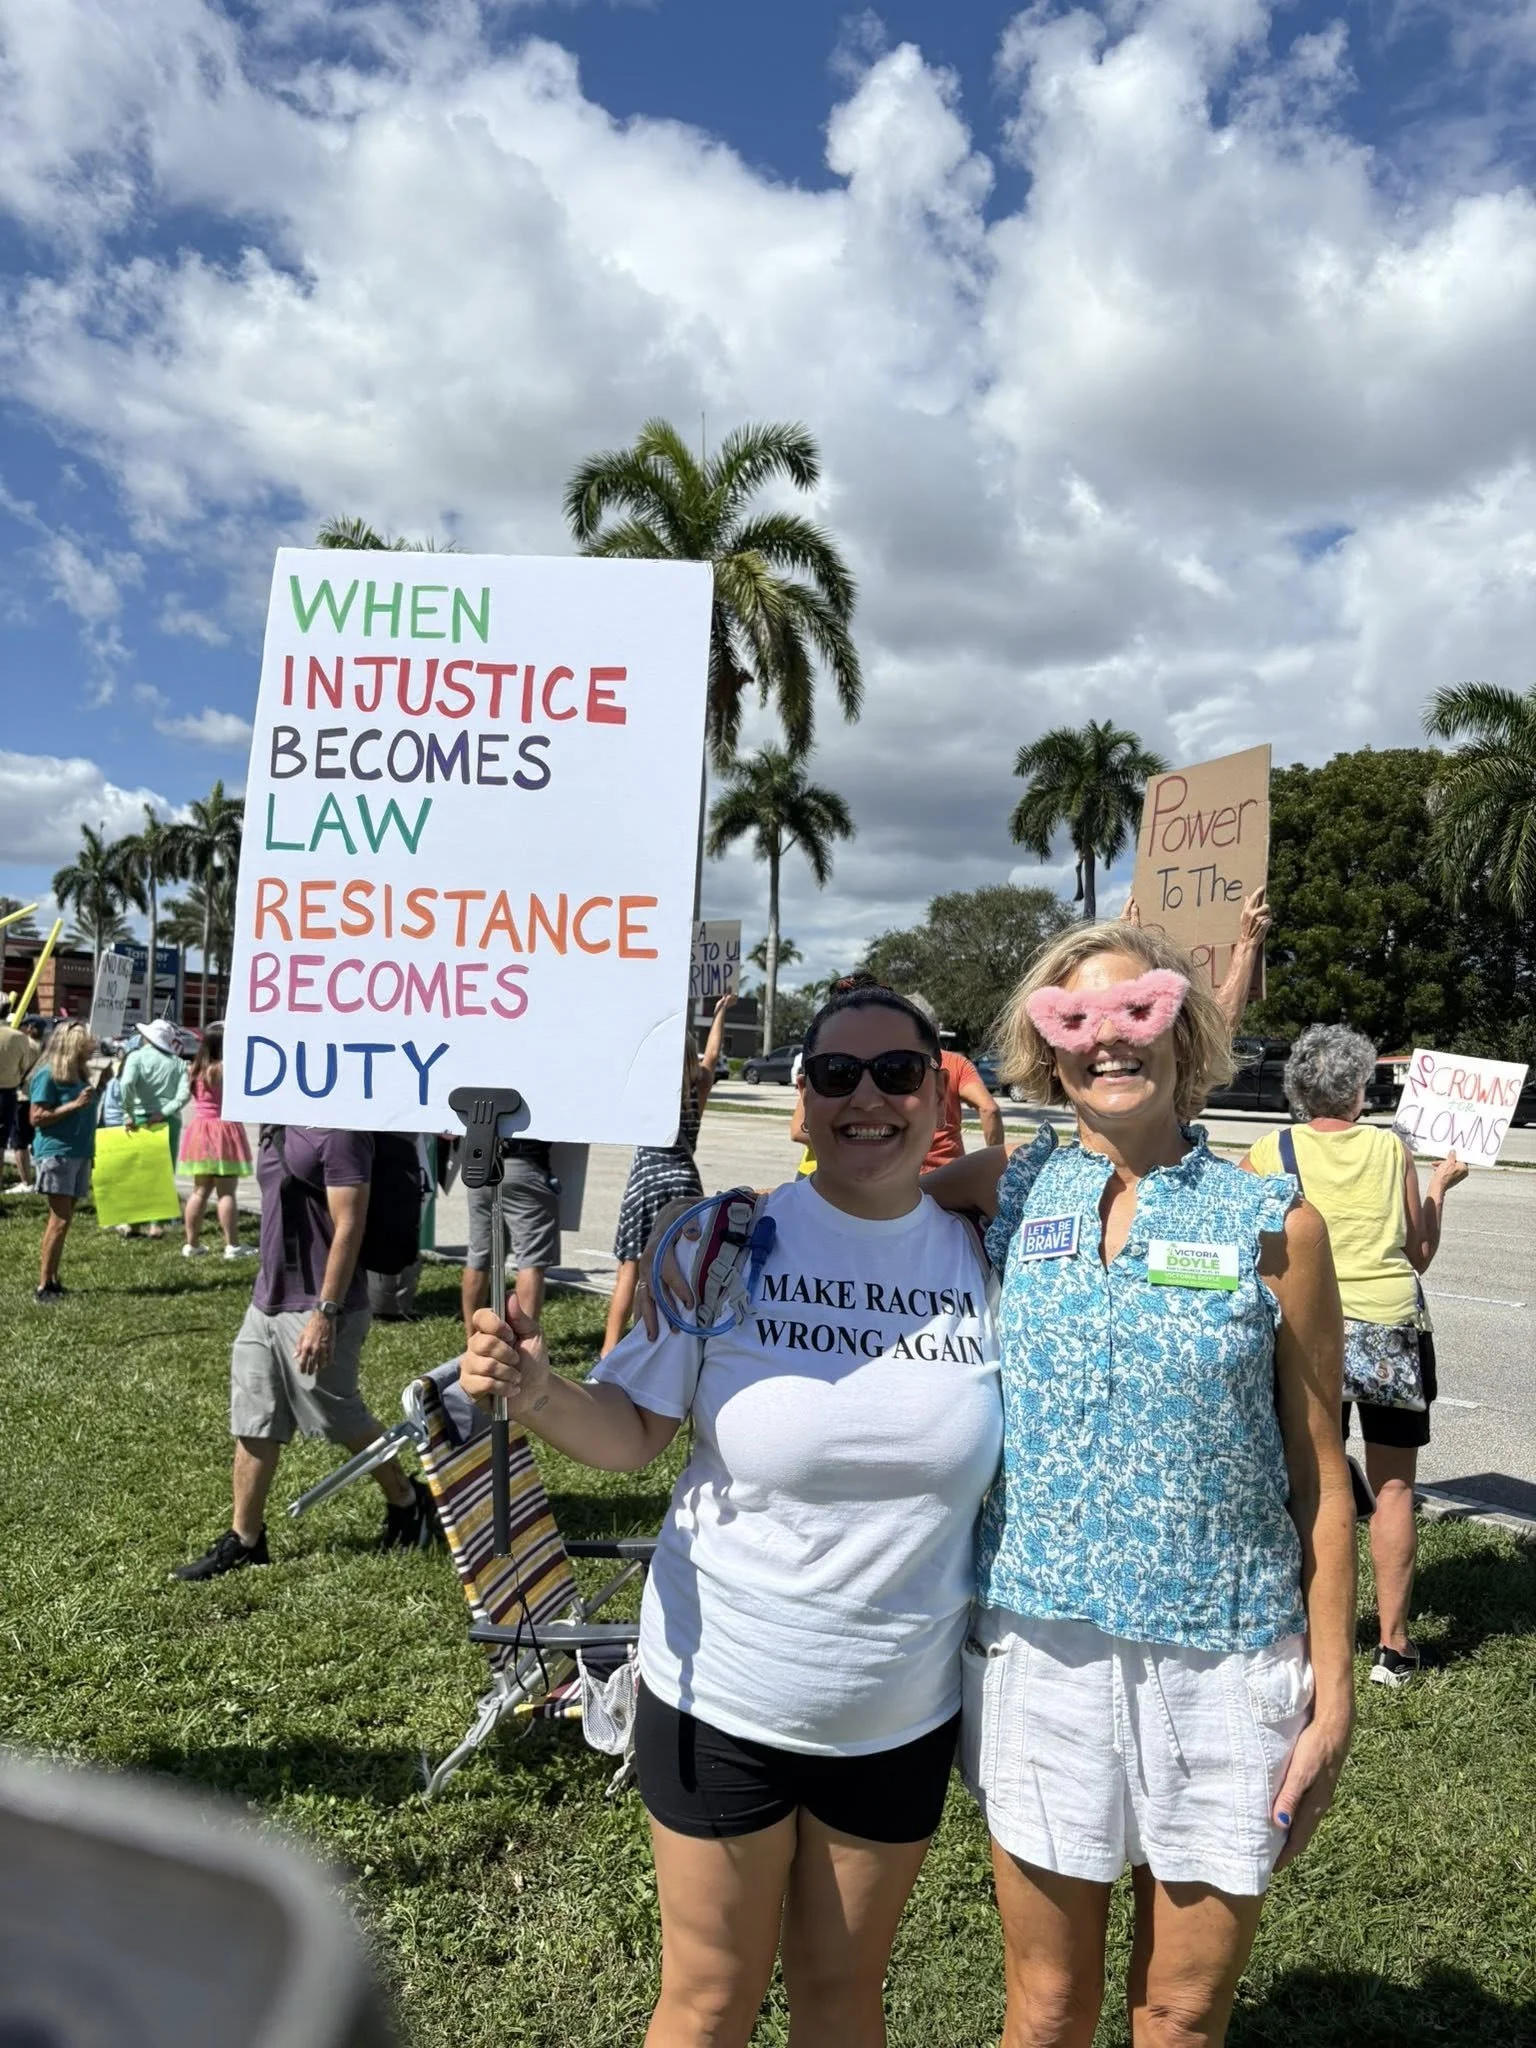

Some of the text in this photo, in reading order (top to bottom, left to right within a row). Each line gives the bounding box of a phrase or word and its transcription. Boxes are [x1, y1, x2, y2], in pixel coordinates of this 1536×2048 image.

[290, 575, 490, 643] WHEN
[282, 655, 627, 725] INJUSTICE
[271, 726, 551, 789] BECOMES
[265, 792, 432, 854] LAW
[1148, 775, 1258, 857] Power
[1157, 863, 1243, 911] To The
[254, 877, 659, 960] RESISTANCE
[125, 947, 170, 962] Taner
[700, 942, 720, 962] TO
[249, 952, 529, 1019] BECOMES
[689, 963, 733, 996] RUMP
[244, 1036, 449, 1105] DUTY
[1409, 1055, 1521, 1107] NO CROWNS
[1396, 1104, 1508, 1155] CLOWNS
[1026, 1231, 1071, 1253] BRAVE
[1028, 1220, 1072, 1236] LET'S BE
[1166, 1256, 1220, 1270] DOYLE
[1175, 1249, 1219, 1258] VICTORIA
[760, 1274, 978, 1318] MAKE RACISM
[755, 1319, 985, 1365] WRONG AGAIN
